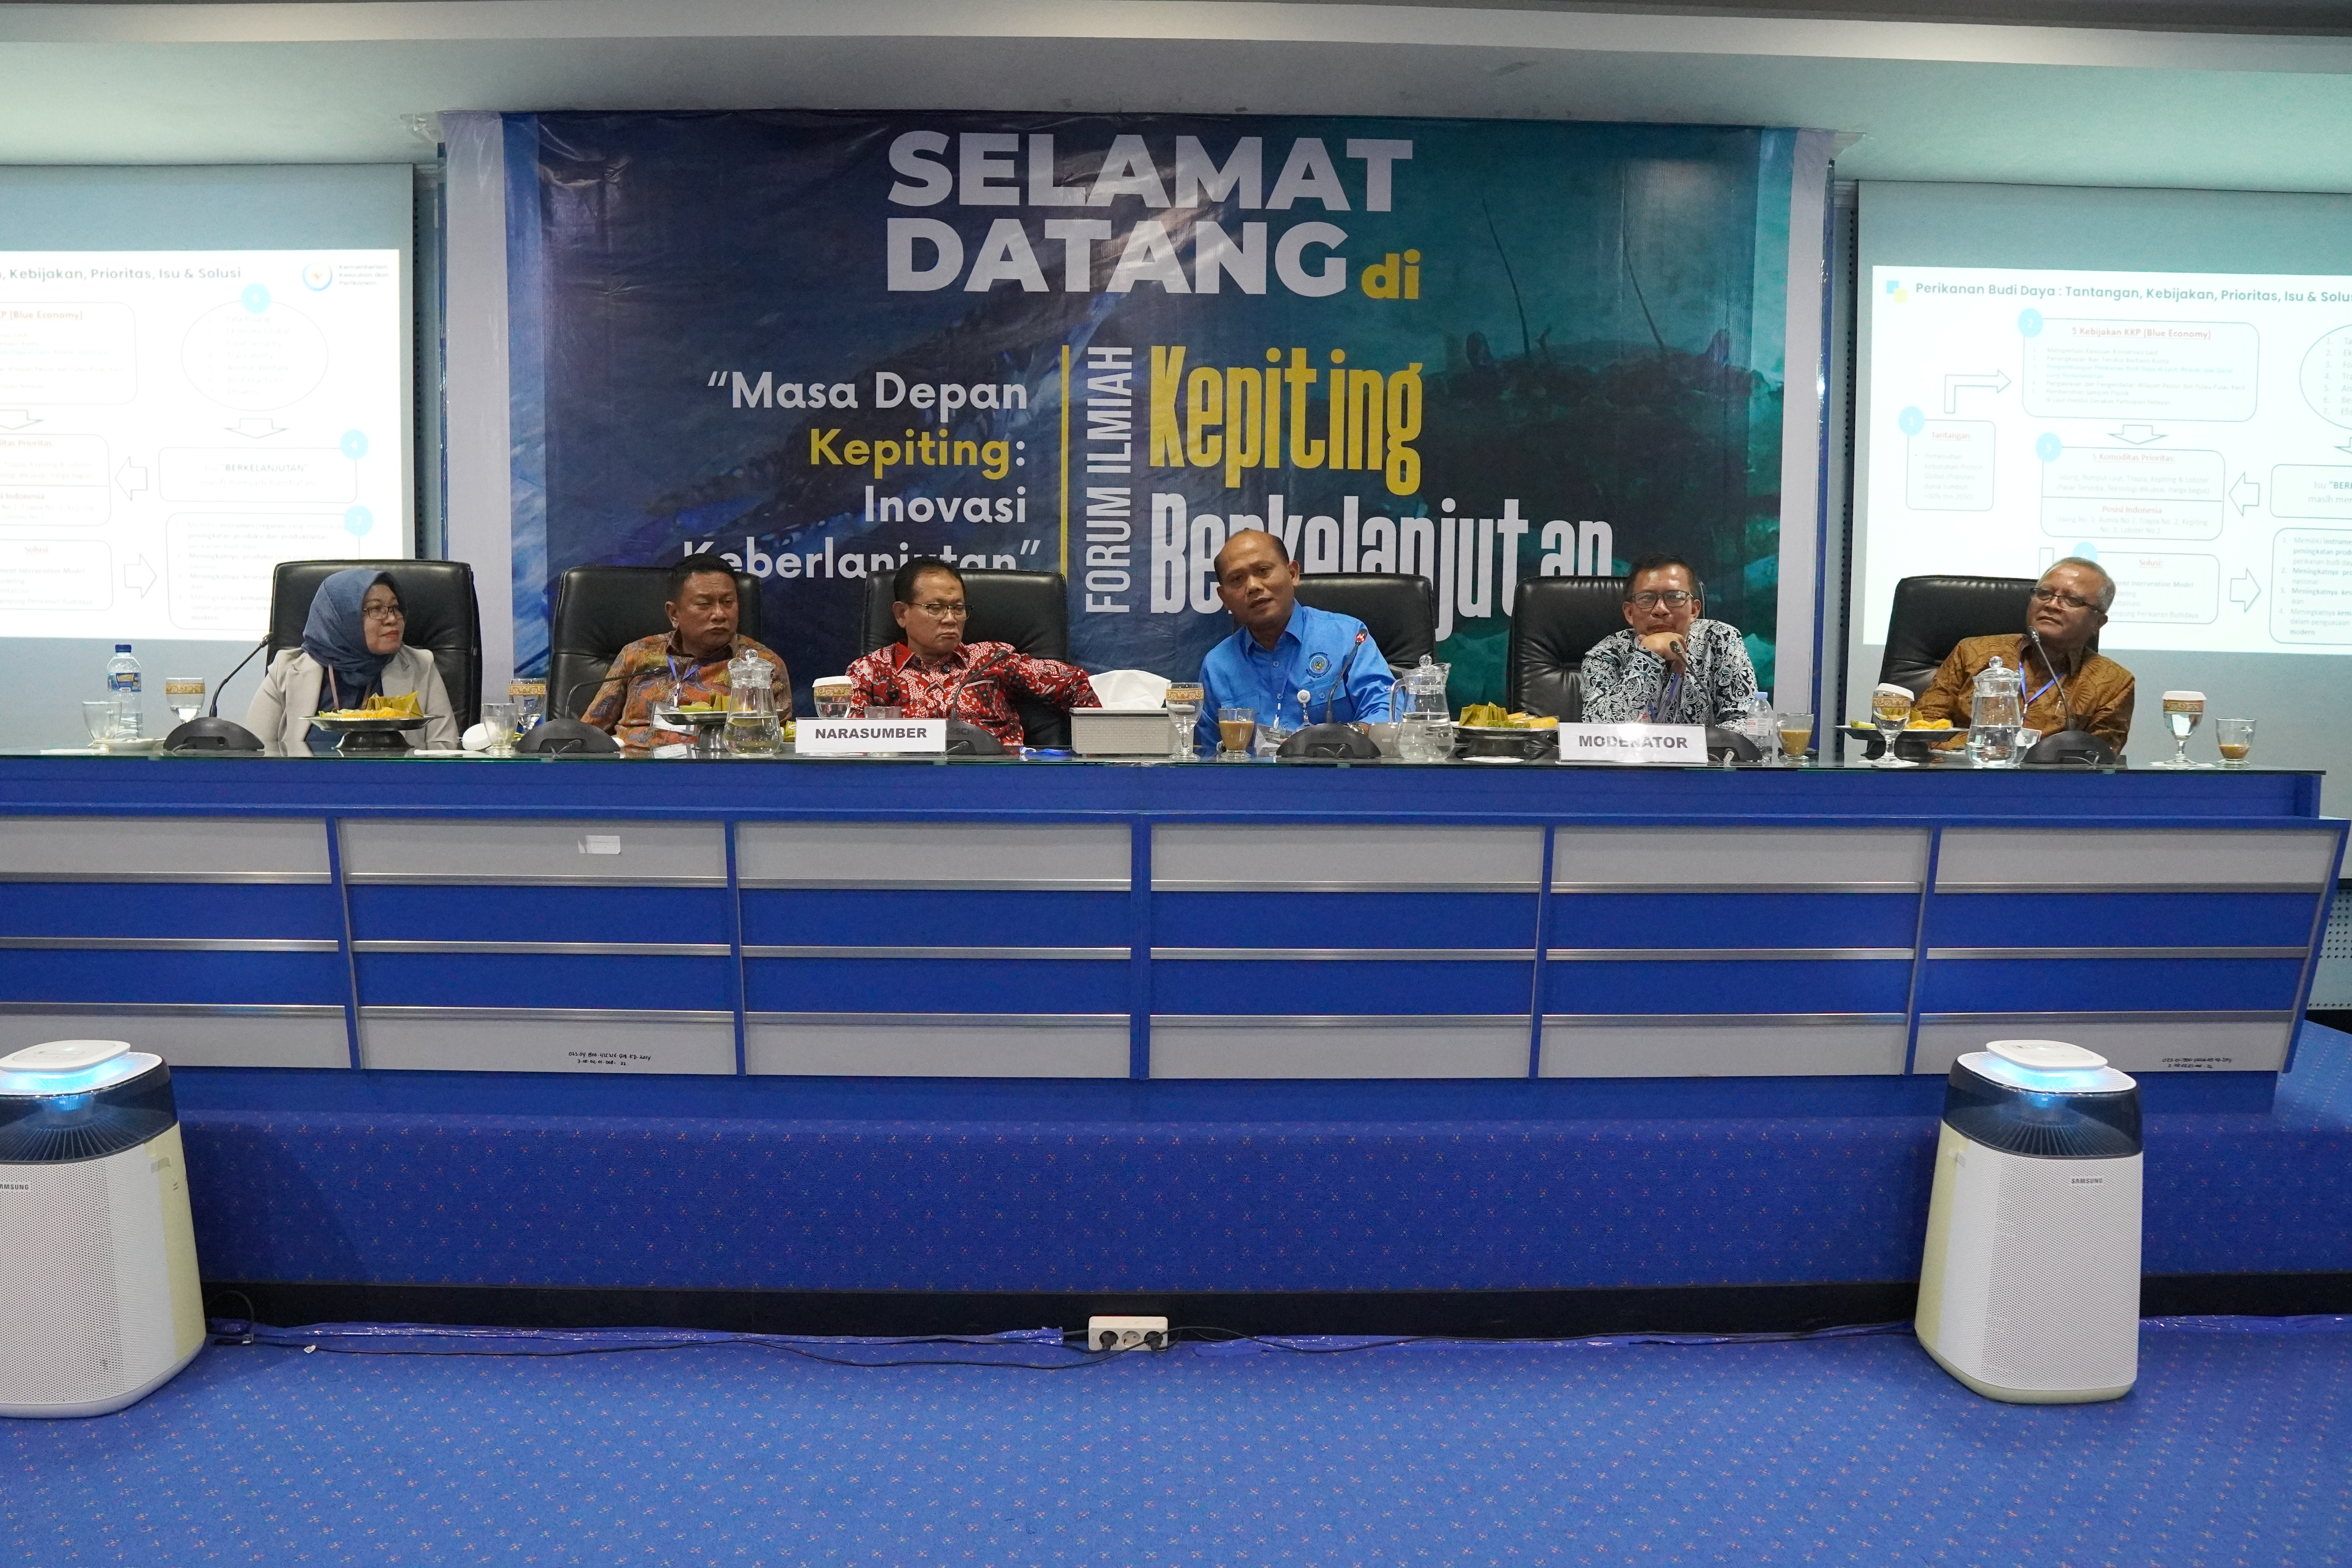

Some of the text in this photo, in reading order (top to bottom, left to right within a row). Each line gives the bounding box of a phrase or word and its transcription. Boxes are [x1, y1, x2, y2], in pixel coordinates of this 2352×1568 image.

[887, 131, 1413, 212] SELAMAT
[9, 268, 87, 282] Kebijakan,
[91, 268, 154, 282] Prioritas,
[160, 267, 180, 278] Isu
[199, 267, 241, 278] Solusi
[887, 218, 1419, 299] DATANG di
[1916, 282, 1985, 294] Perikanan
[1989, 284, 2017, 295] Budi
[2021, 285, 2055, 299] Daya
[2066, 285, 2142, 300] Tantangan,
[2147, 287, 2217, 302] Kebijakan,
[2221, 289, 2281, 303] Prioritas,
[2285, 290, 2304, 301] Isu
[2080, 327, 2122, 338] Kebijakan
[2144, 329, 2166, 339] (Blue
[2169, 330, 2211, 340] Economy)
[707, 371, 1027, 423] “Masa Depan
[1150, 346, 1423, 496] Kepiting
[1932, 432, 1972, 441] Tantangan:
[810, 428, 1025, 480] Kepiting:
[1085, 347, 1132, 613] FORUM ILMIAH
[865, 485, 1026, 523] Inovasi
[815, 728, 927, 739] NARASUMBER
